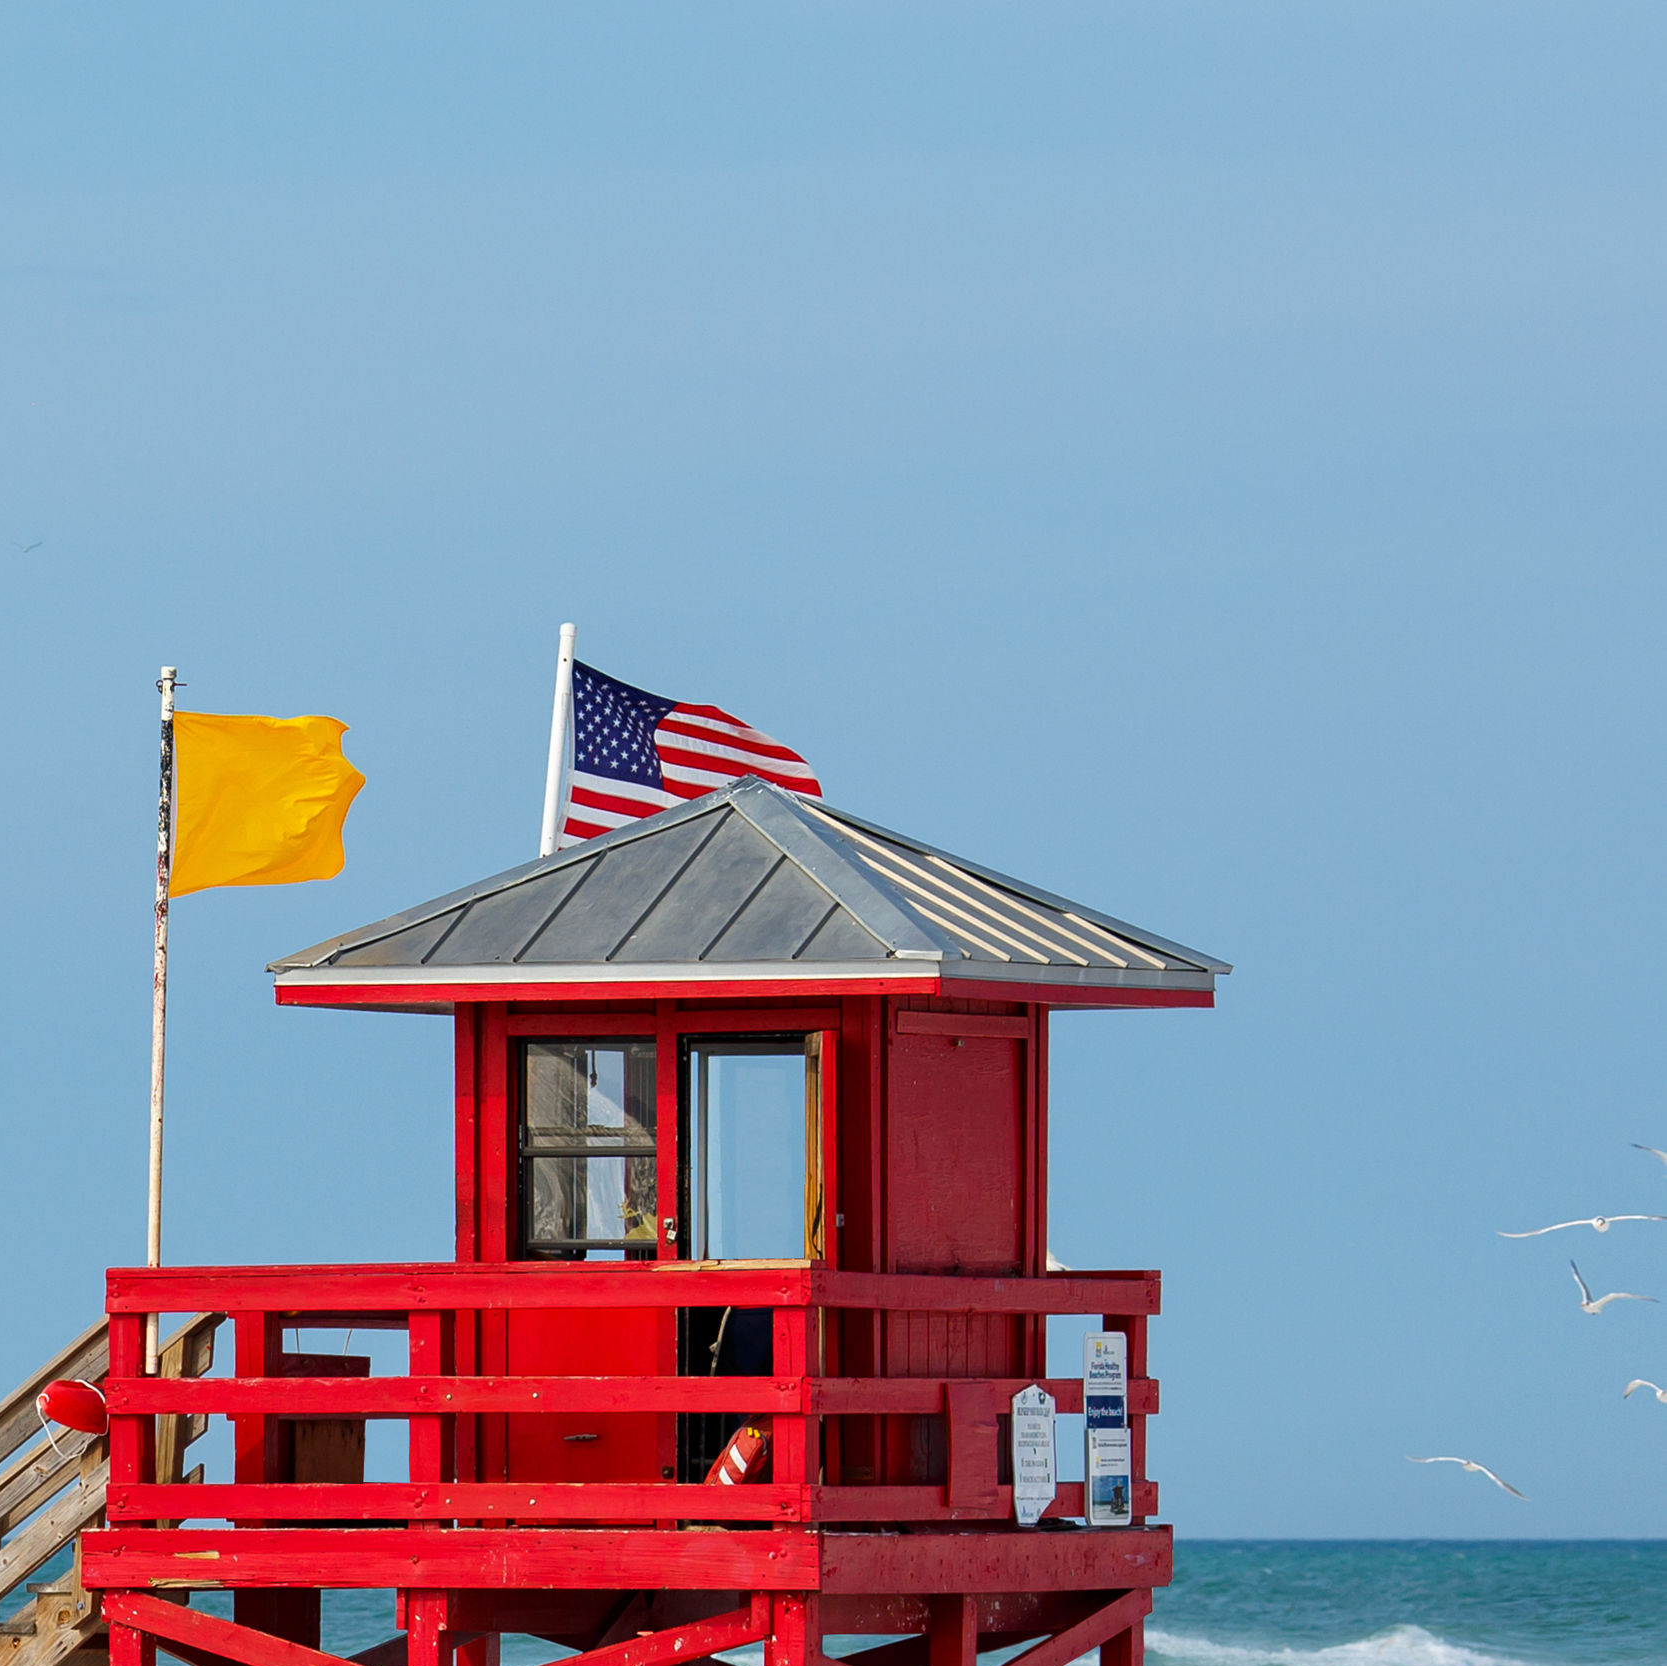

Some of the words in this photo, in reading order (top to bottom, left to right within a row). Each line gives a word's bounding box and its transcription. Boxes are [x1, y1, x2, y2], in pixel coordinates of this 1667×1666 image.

[1105, 1370, 1121, 1381] Program
[1088, 1406, 1100, 1418] Enjoy
[1108, 1406, 1123, 1416] beach!
